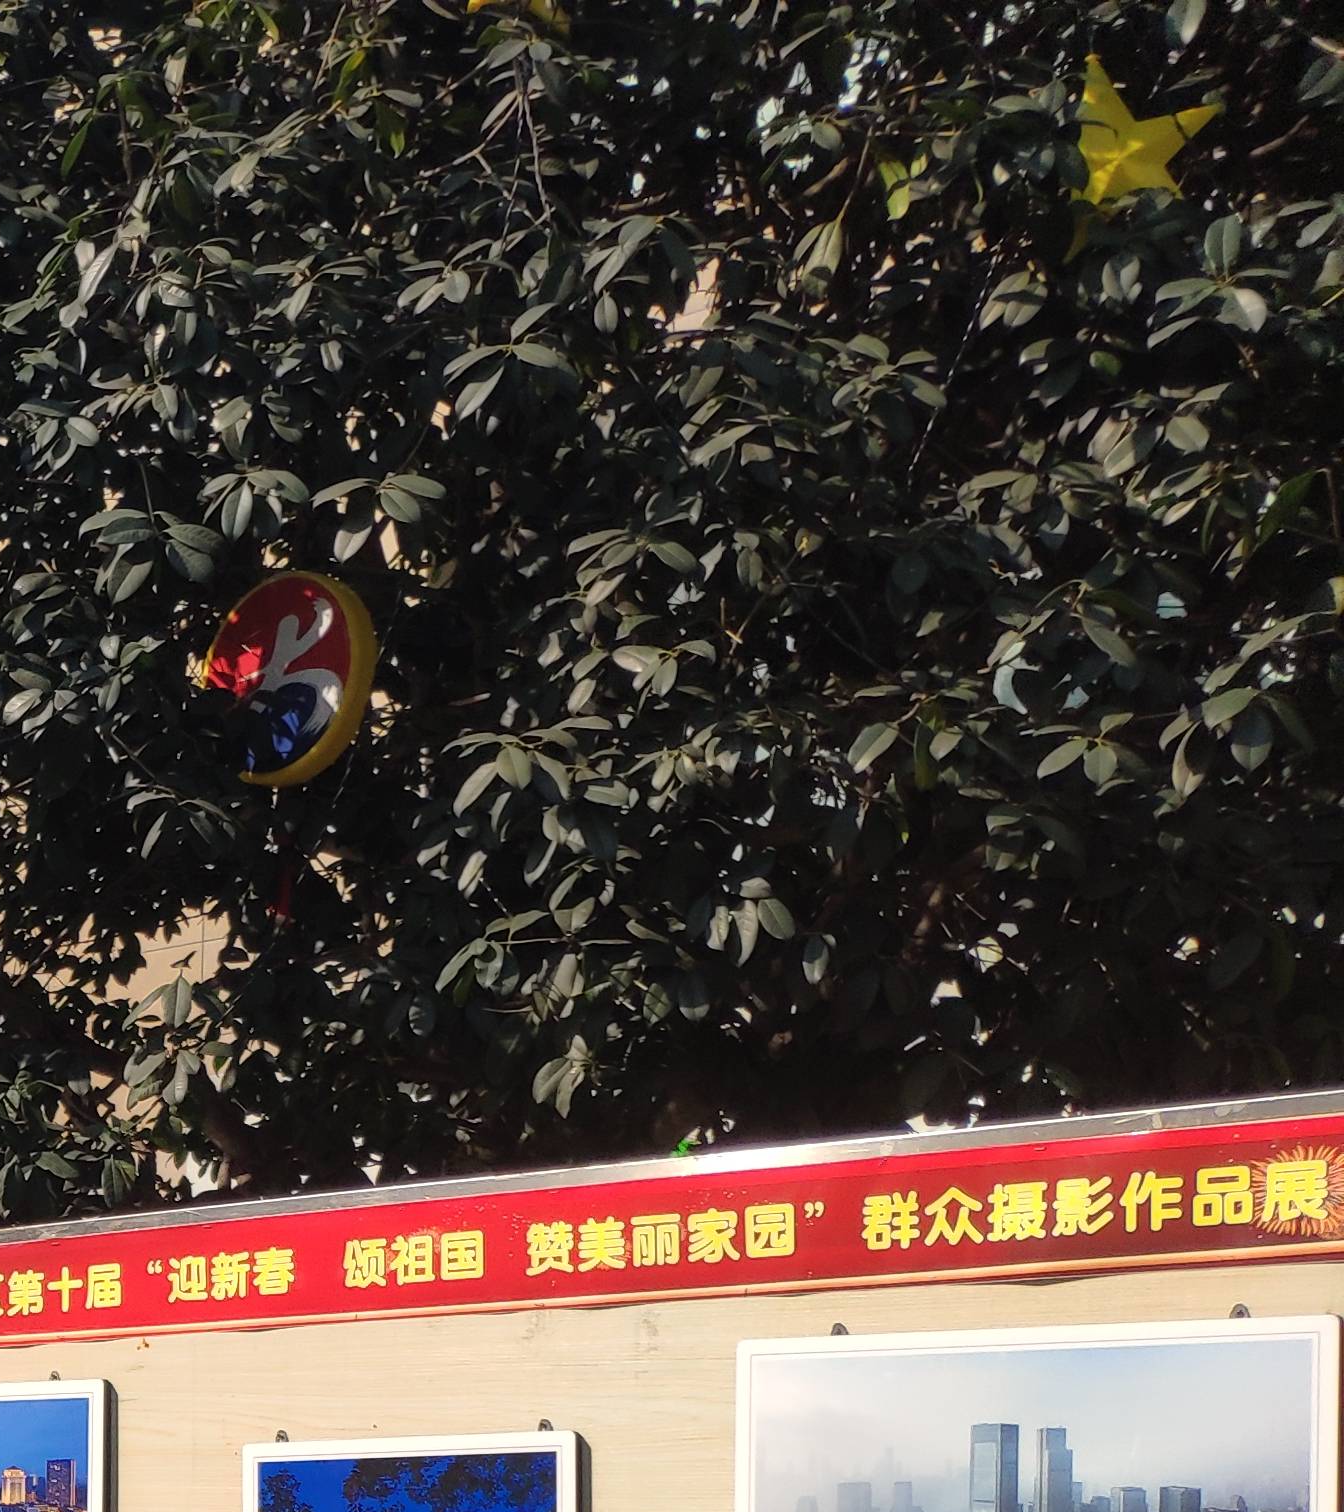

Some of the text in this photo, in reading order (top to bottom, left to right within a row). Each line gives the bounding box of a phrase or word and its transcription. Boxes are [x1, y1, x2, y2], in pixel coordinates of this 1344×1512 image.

[147, 1247, 295, 1304] “迎新春
[343, 1230, 484, 1288] 颂祖国
[525, 1202, 825, 1278] 赞美丽家园”
[862, 1160, 1329, 1251] 群众摄影作品展
